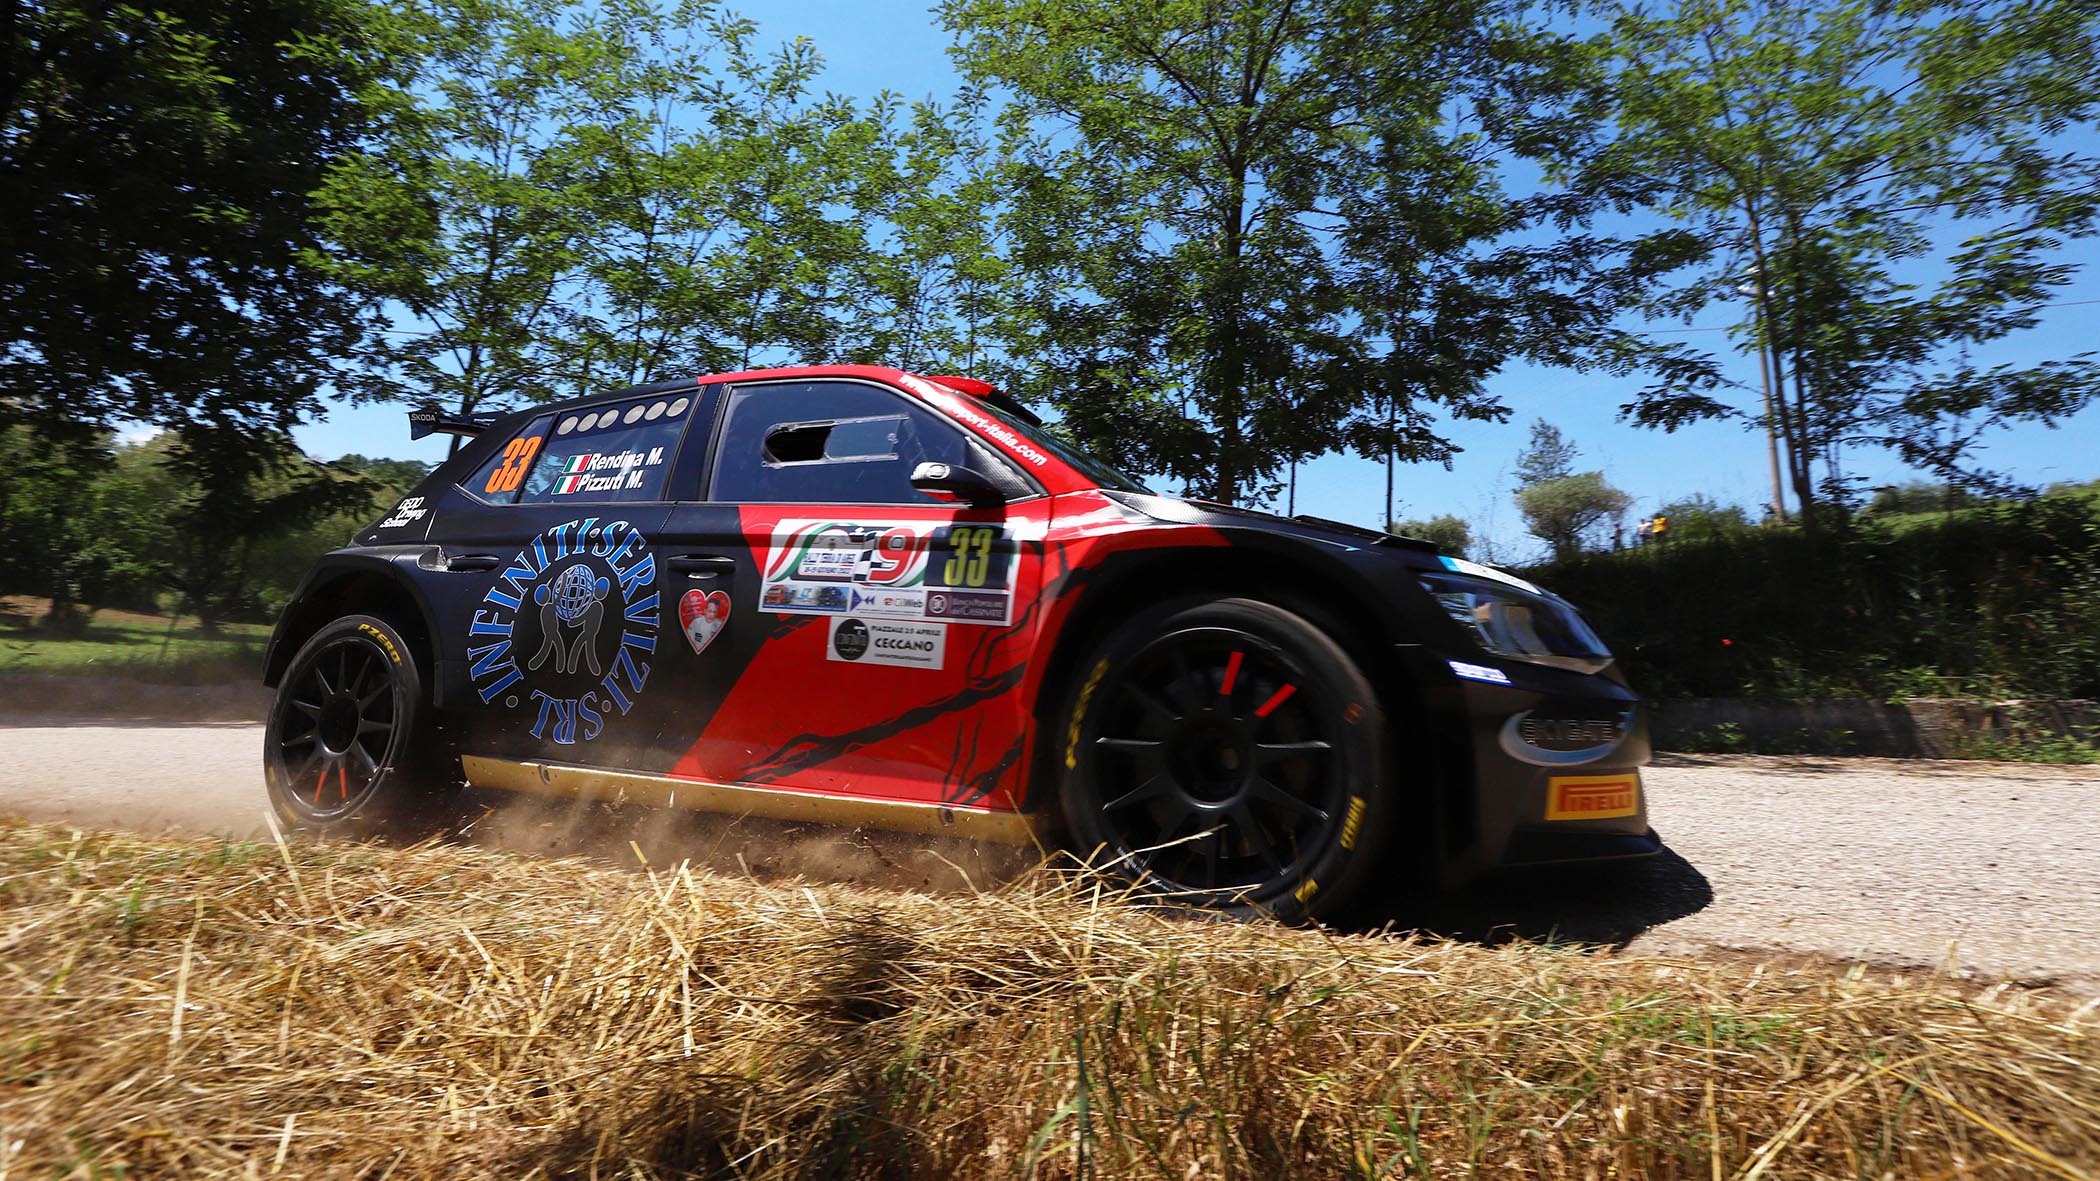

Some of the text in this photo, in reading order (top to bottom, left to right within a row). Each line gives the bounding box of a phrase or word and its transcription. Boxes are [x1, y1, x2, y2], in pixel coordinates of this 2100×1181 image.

[485, 436, 543, 494] 33
[587, 446, 664, 471] Rendina M.
[576, 470, 644, 492] Pizzuti M.
[943, 527, 995, 588] 33
[467, 517, 661, 745] INFINITI SERVIZI SRL
[875, 638, 934, 652] CECCANO
[1557, 781, 1633, 813] PIRELLI
